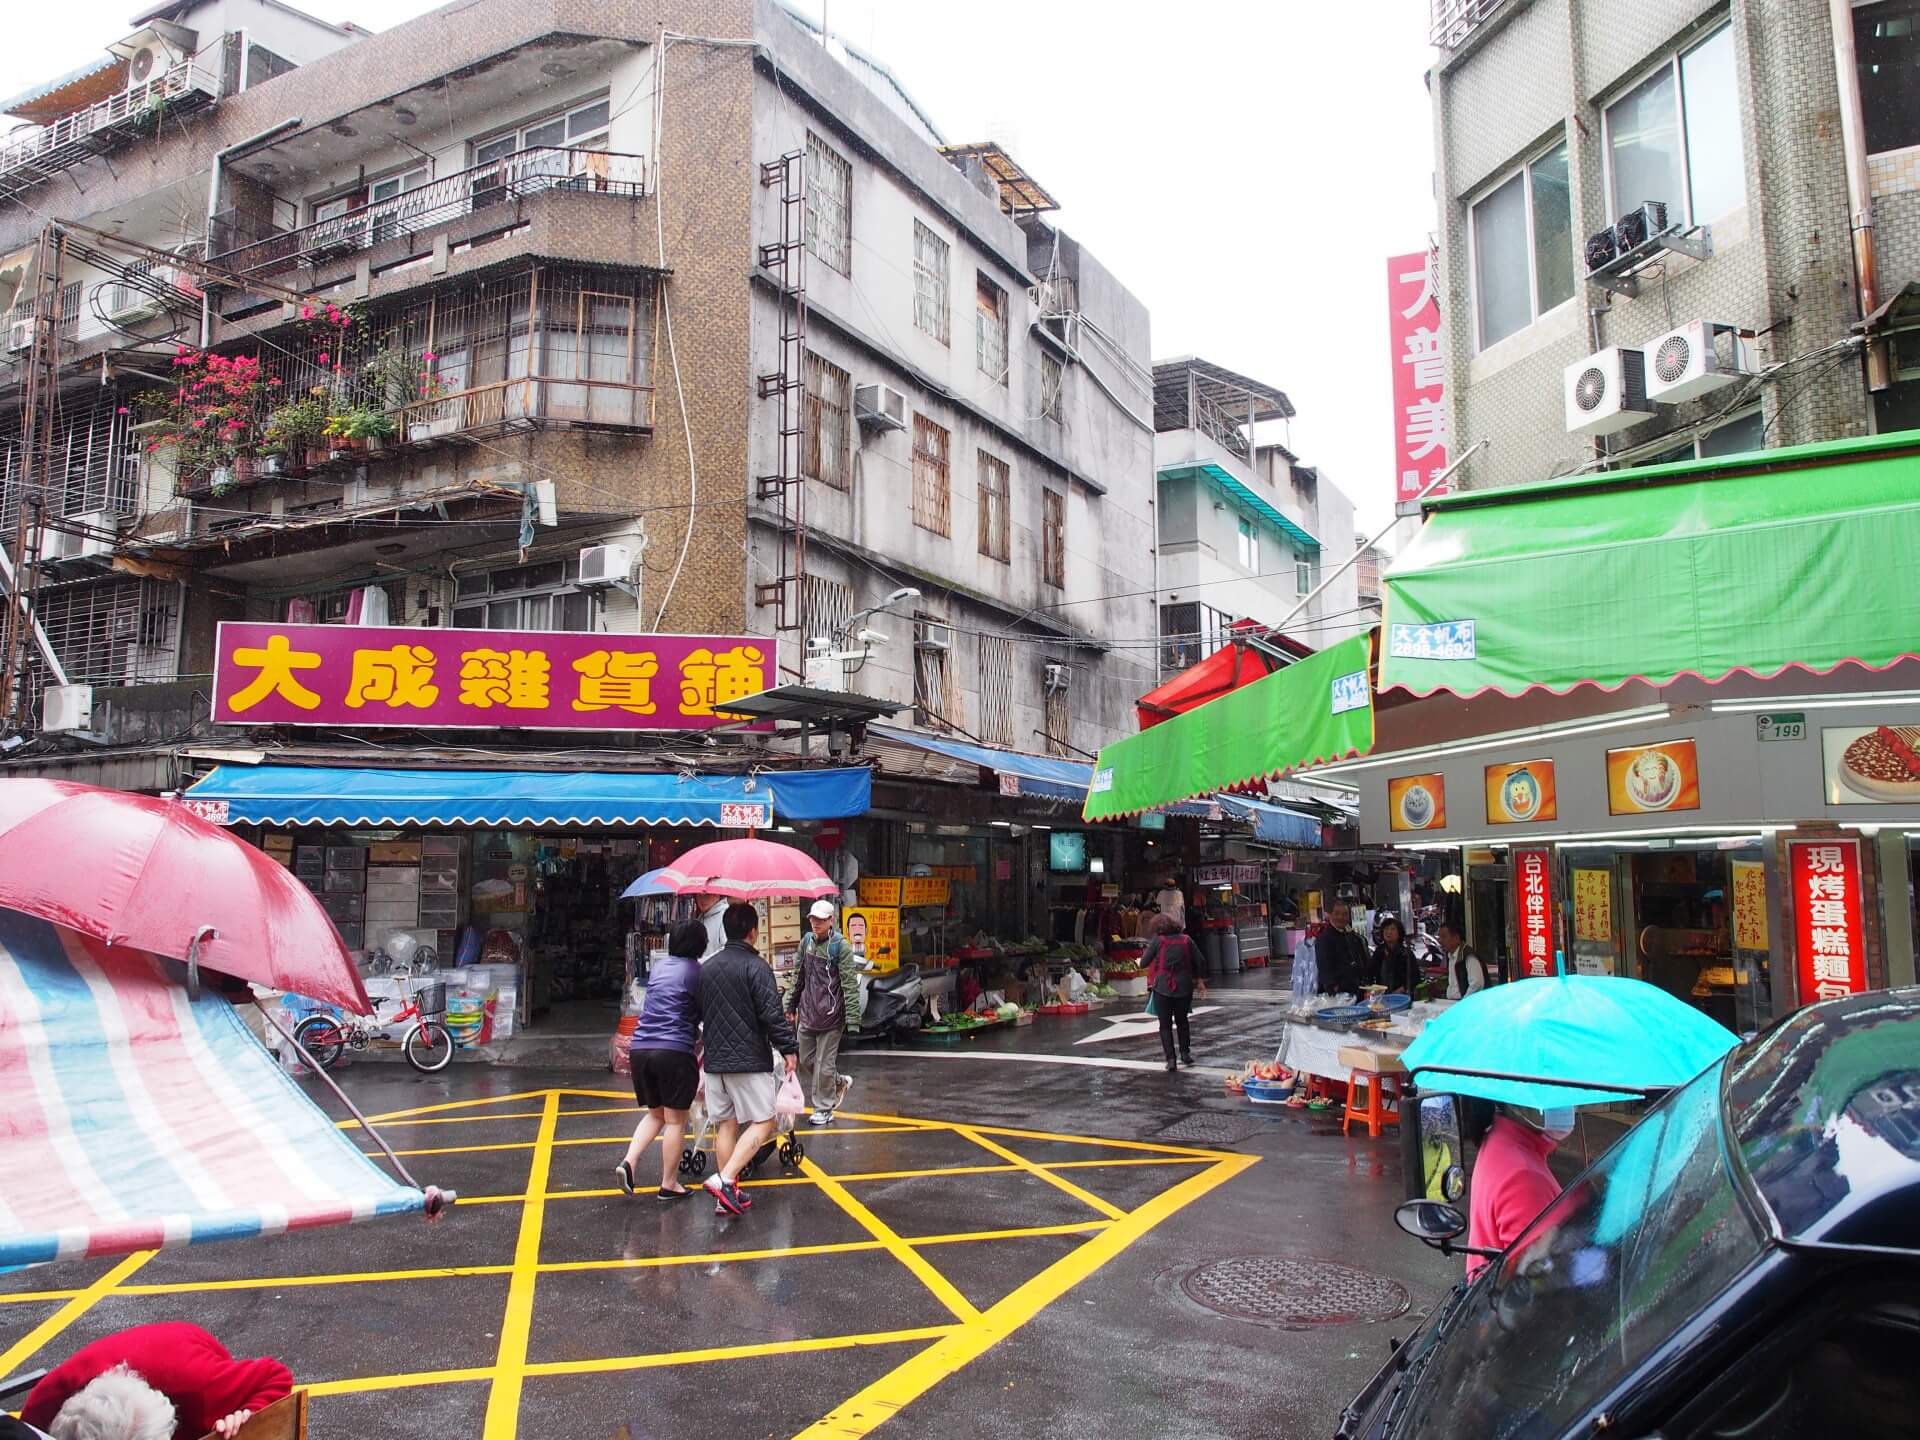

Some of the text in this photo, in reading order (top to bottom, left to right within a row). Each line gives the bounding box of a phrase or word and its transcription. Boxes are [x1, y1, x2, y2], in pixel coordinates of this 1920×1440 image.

[1394, 641, 1473, 657] 2898-4692
[228, 634, 766, 721] 大成雜貨鋪
[1774, 724, 1801, 737] 199
[870, 911, 897, 923] 小胖子
[1524, 854, 1548, 977] 台北伴手禮盒
[1807, 846, 1852, 1001] 現烤蛋糕麵包
